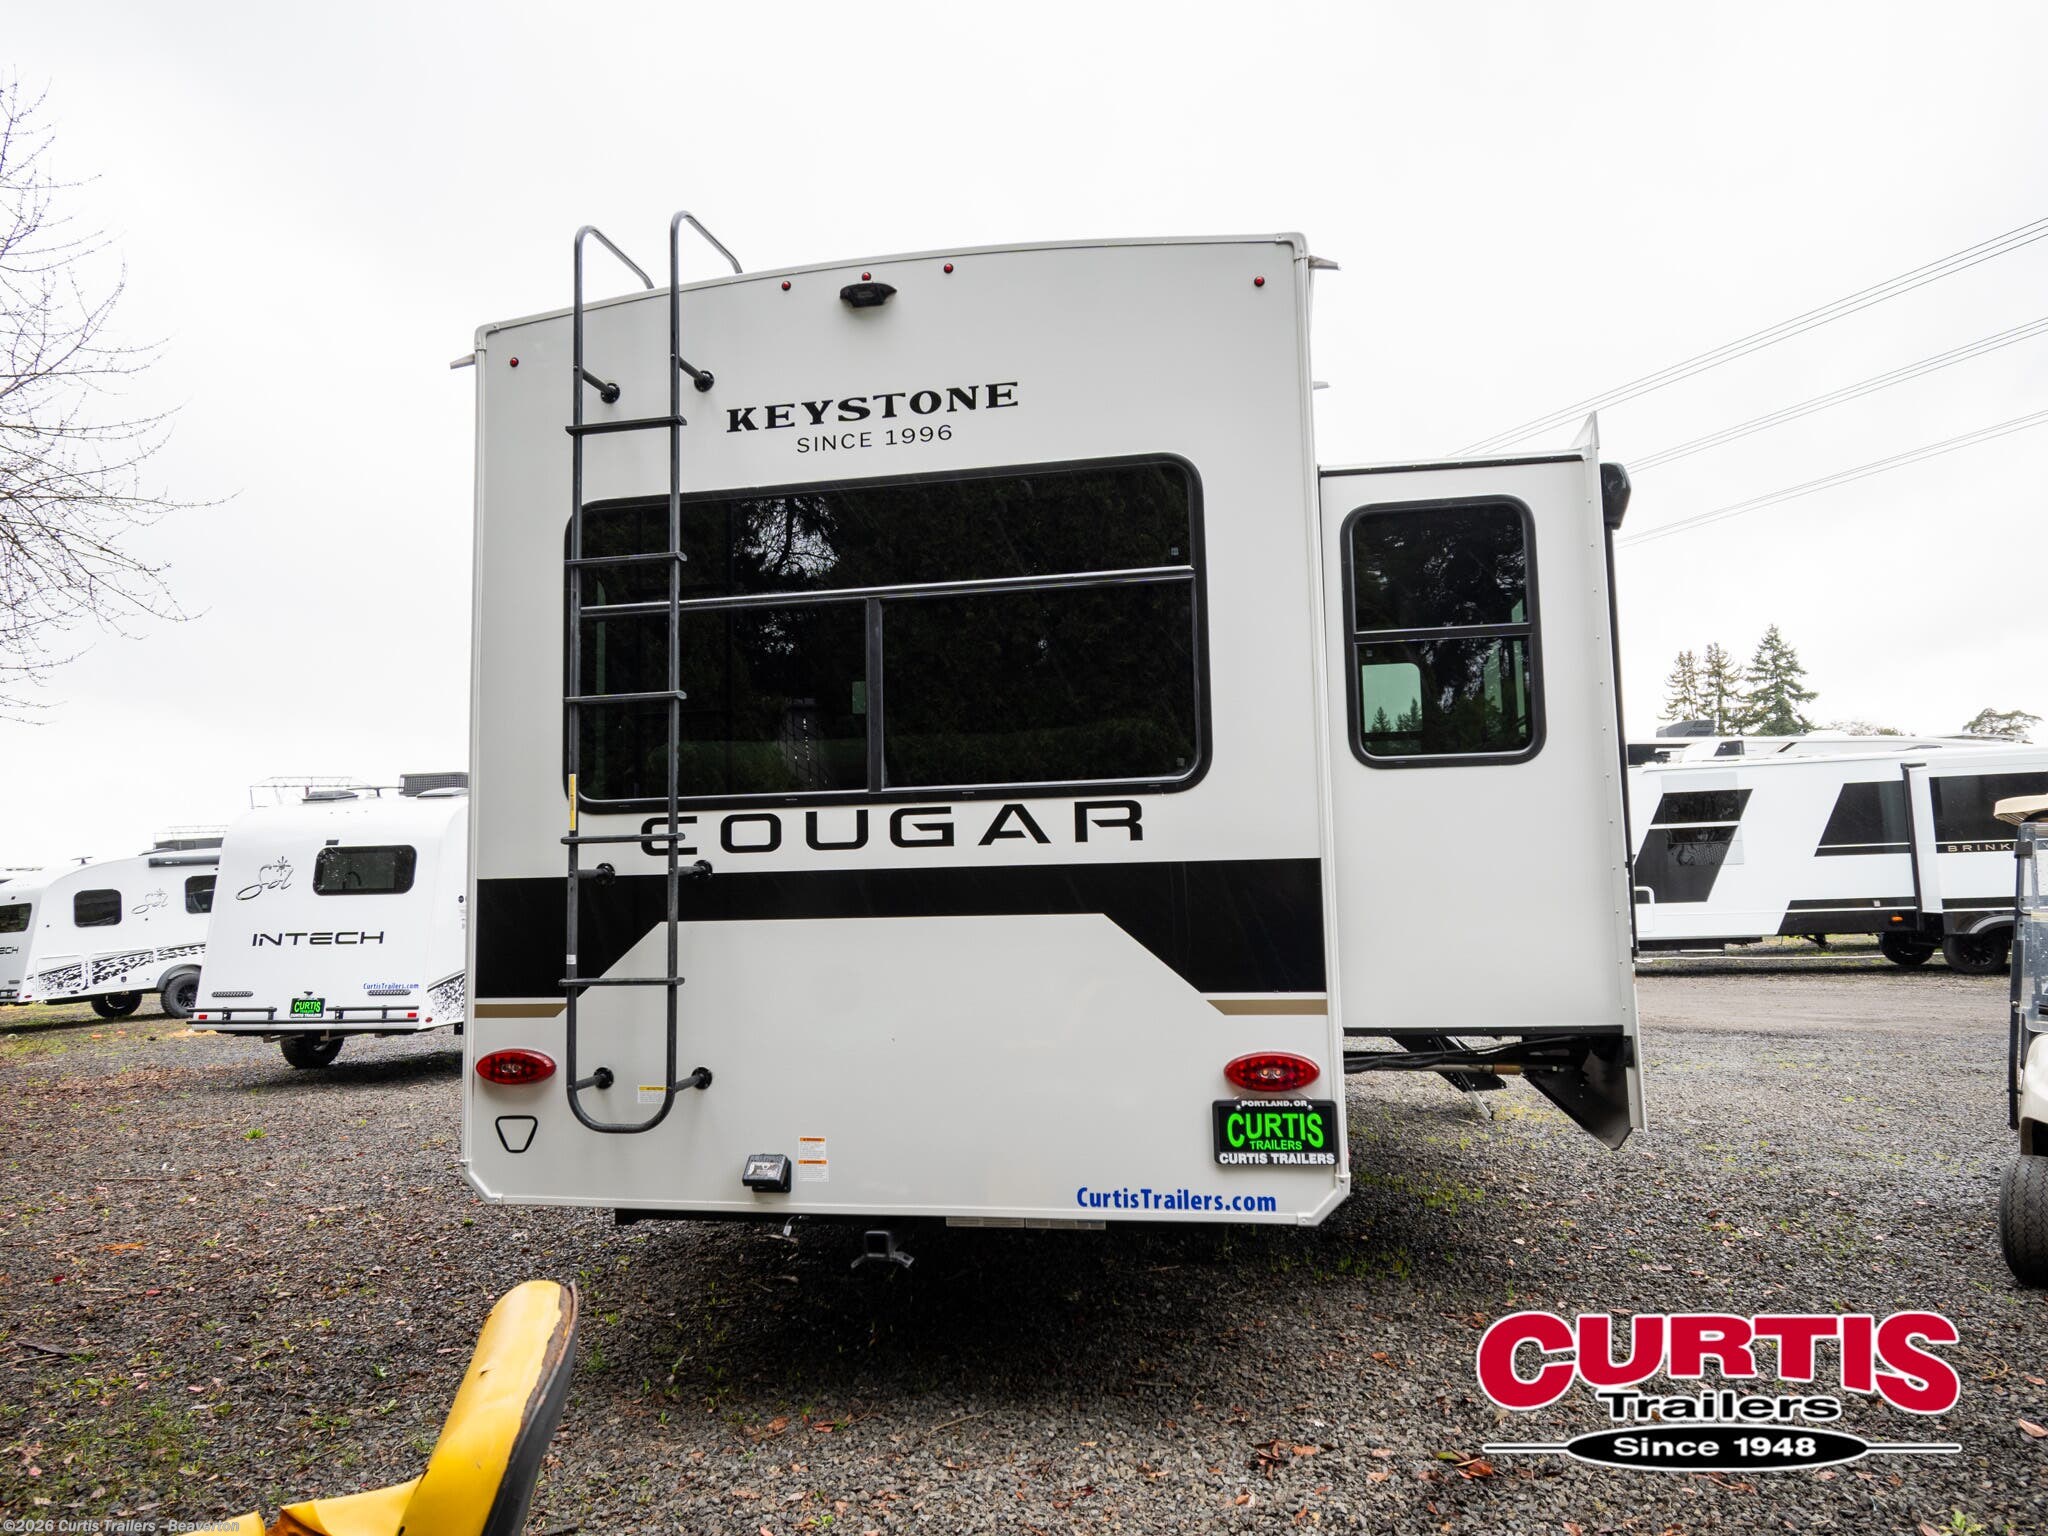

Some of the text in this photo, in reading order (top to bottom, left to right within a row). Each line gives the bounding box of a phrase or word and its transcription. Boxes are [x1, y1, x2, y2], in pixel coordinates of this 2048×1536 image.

[726, 381, 1019, 433] KEYSTONE
[796, 424, 952, 453] SINCE 1996
[641, 800, 1143, 856] COUGAR
[252, 931, 384, 947] INTECH
[363, 982, 420, 990] CurtisTrailers.com
[294, 1001, 321, 1013] CURTIS
[1227, 1112, 1324, 1148] CURTIS
[1250, 1141, 1303, 1150] TRAILERS
[1219, 1152, 1336, 1165] CURTIS TRAILERS
[1076, 1186, 1277, 1212] CurtisTrailers.com
